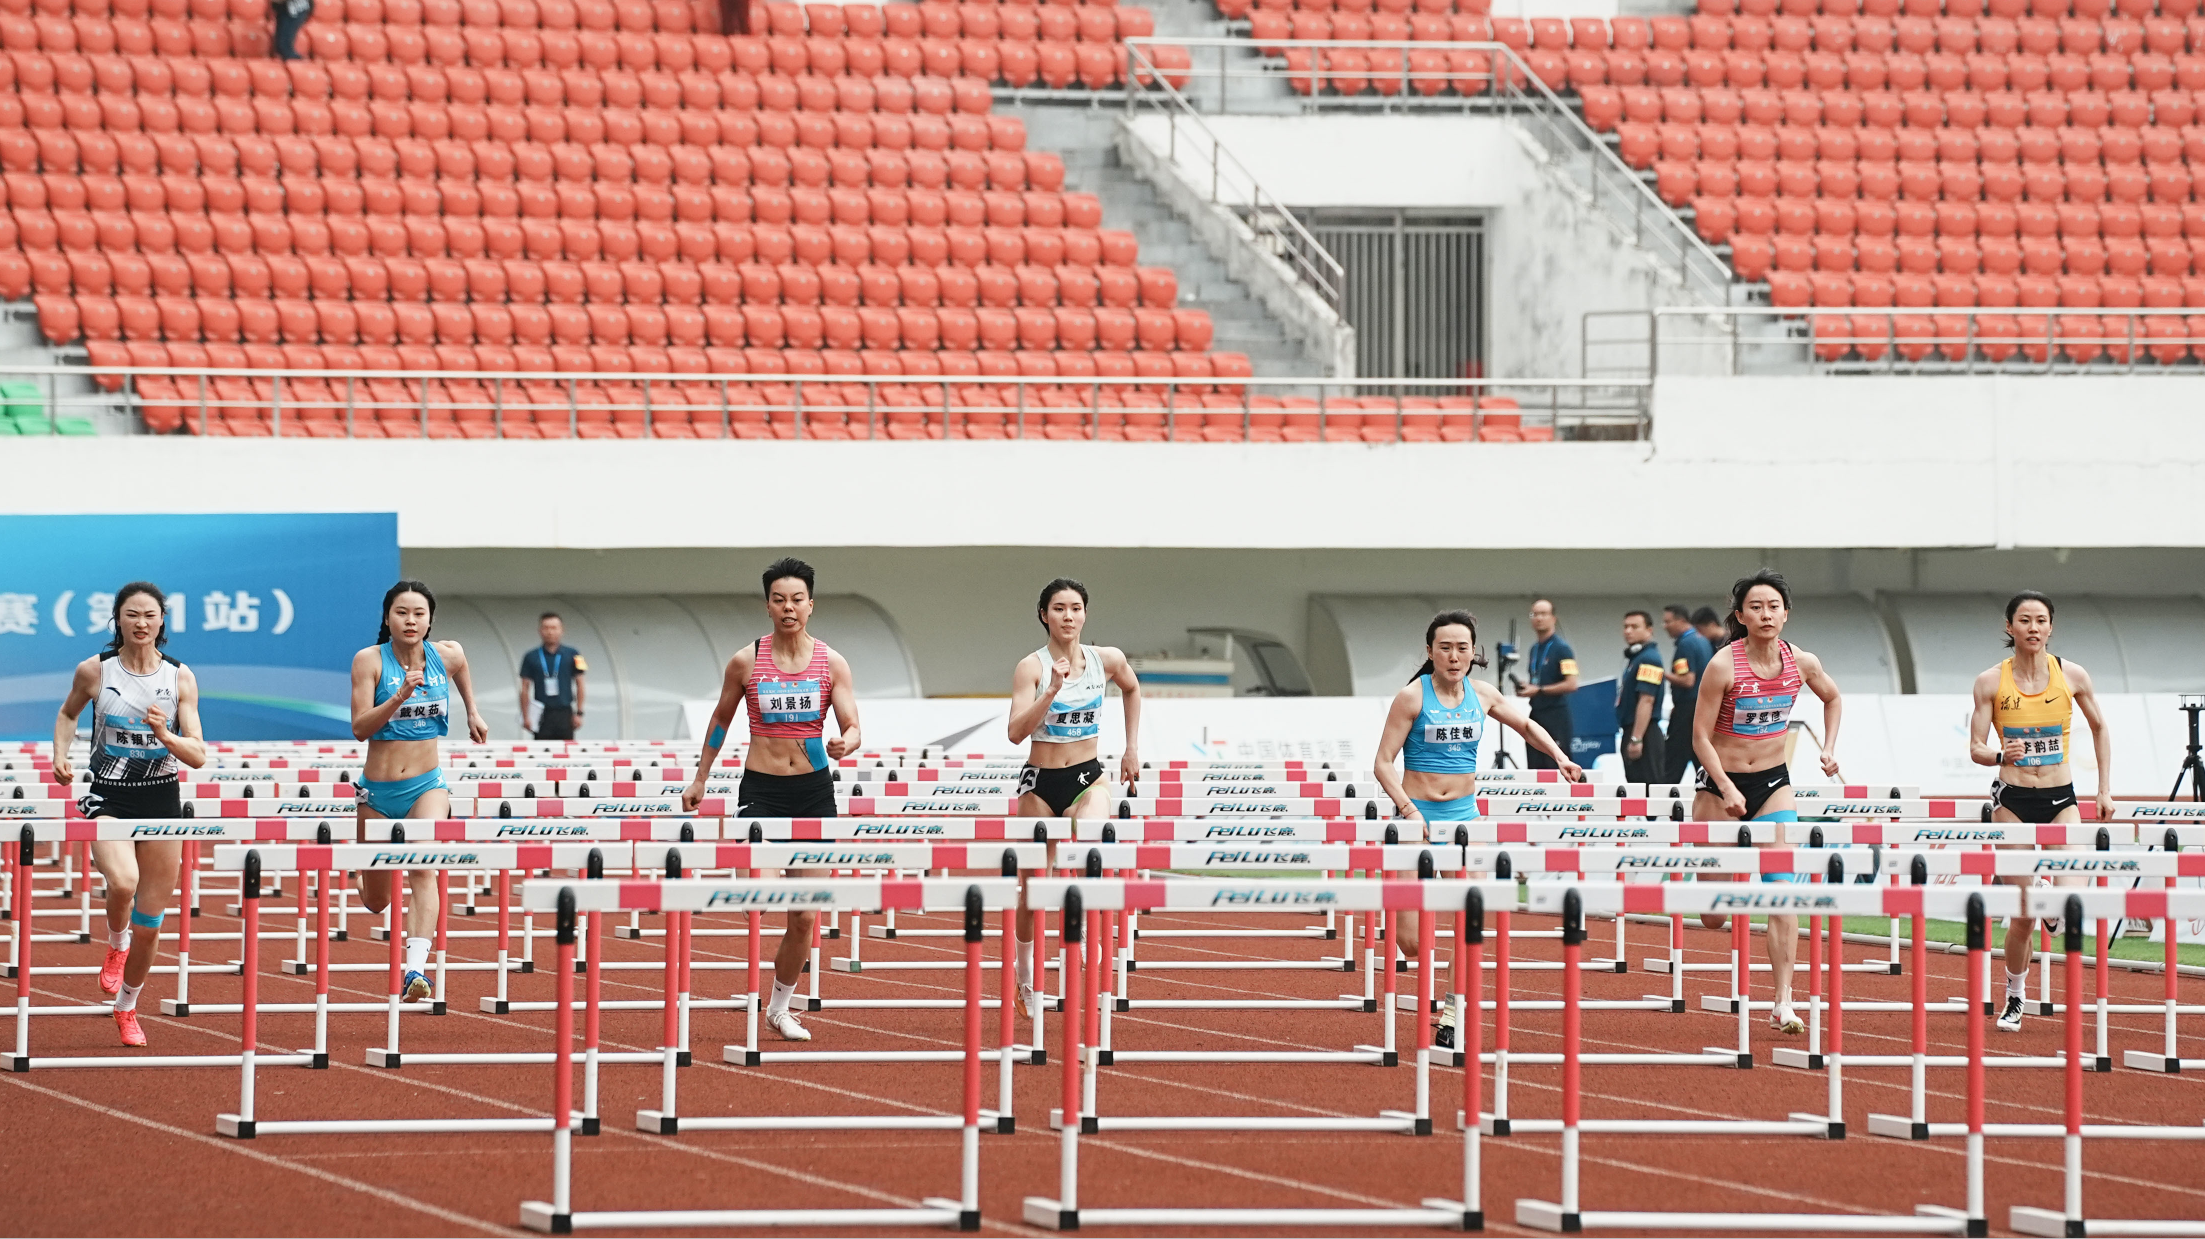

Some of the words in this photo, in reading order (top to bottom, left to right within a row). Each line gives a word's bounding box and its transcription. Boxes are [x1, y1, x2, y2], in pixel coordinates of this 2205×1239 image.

[770, 696, 811, 710] 刘景扬
[785, 714, 799, 722] 191
[1056, 711, 1095, 724] 夏思凝
[1067, 728, 1082, 736] 458
[1436, 726, 1473, 741] 陈佳敏
[116, 731, 158, 746] 陈银凤
[130, 750, 145, 758] 830
[2027, 757, 2041, 766] 106
